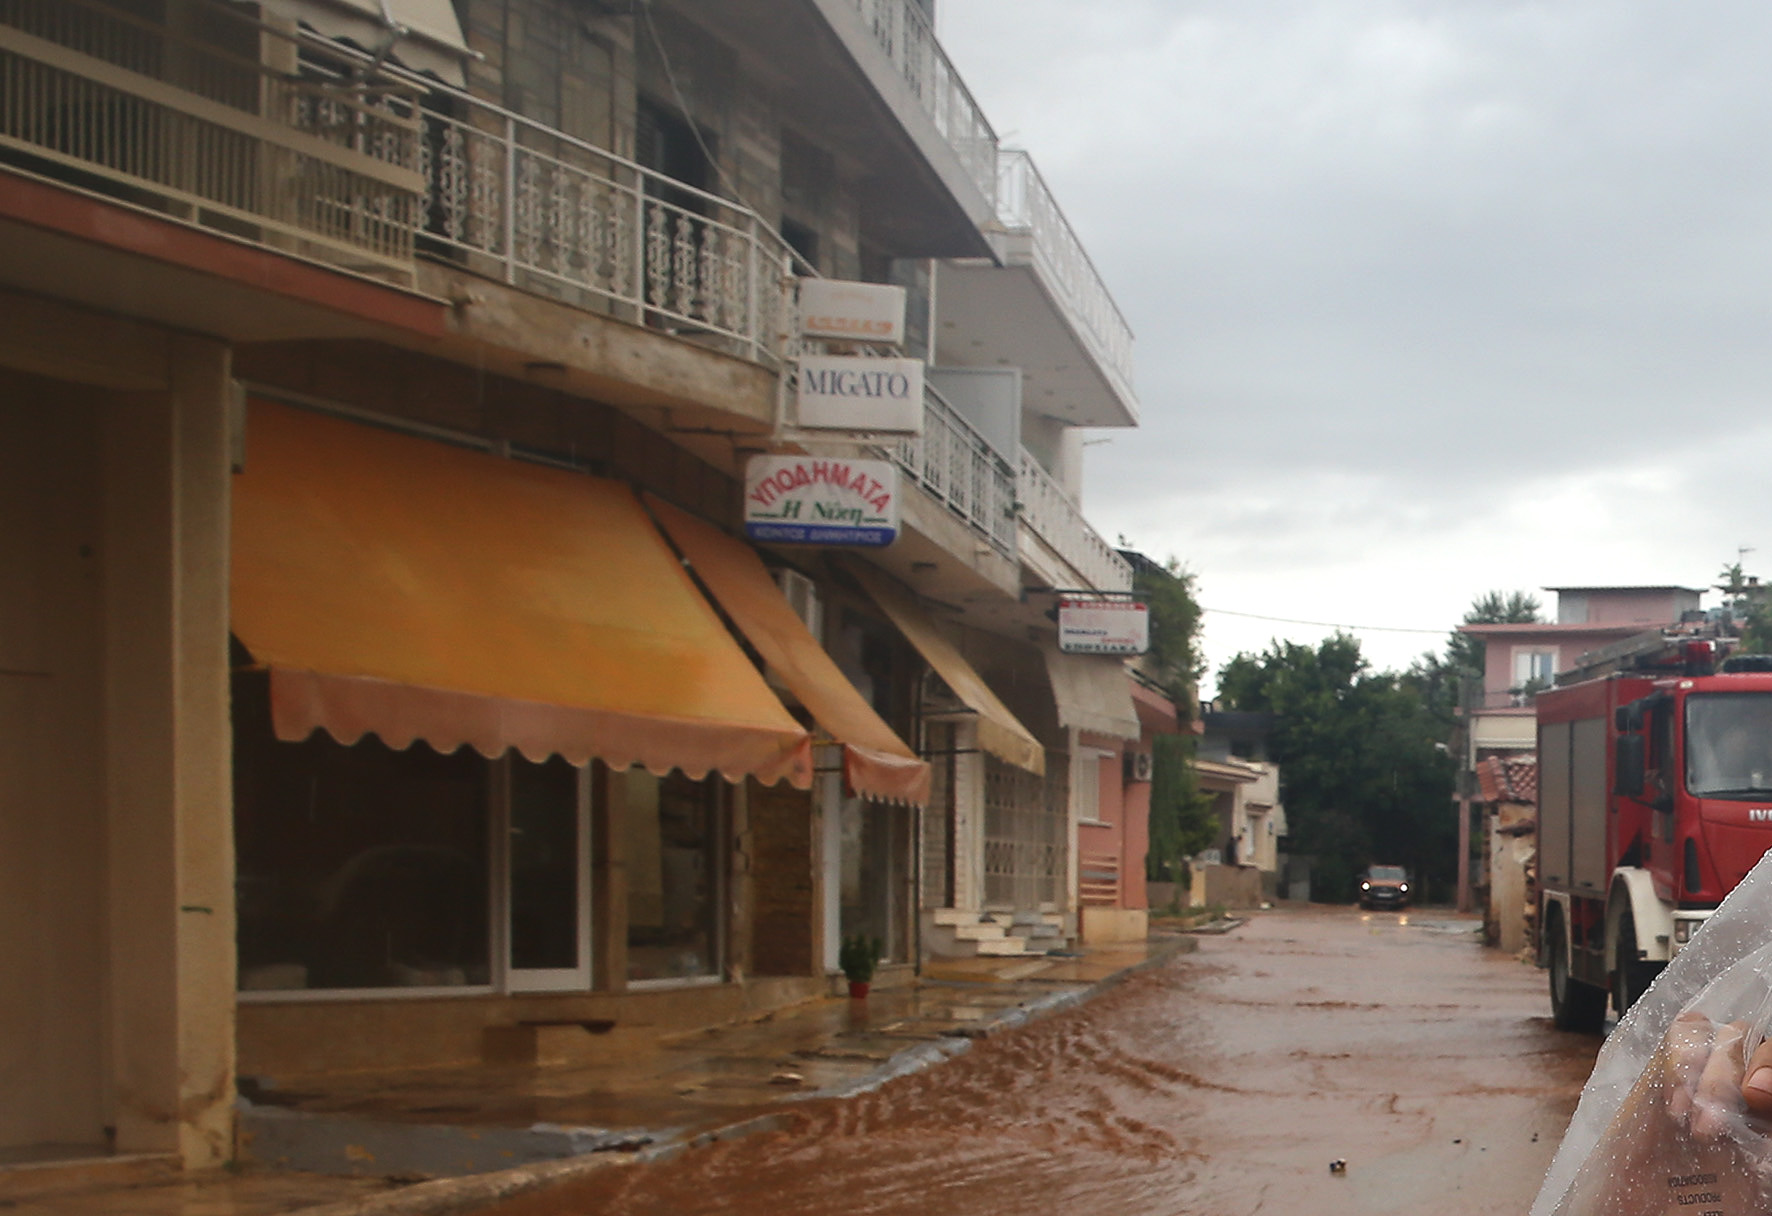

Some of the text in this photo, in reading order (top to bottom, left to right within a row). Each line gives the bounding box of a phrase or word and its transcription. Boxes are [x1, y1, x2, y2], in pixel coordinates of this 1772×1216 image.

[805, 368, 909, 399] MIGATO
[750, 461, 892, 514] ΥΠΟΔΗΜΑΤΑ
[1677, 1192, 1722, 1206] PRODUCTS
